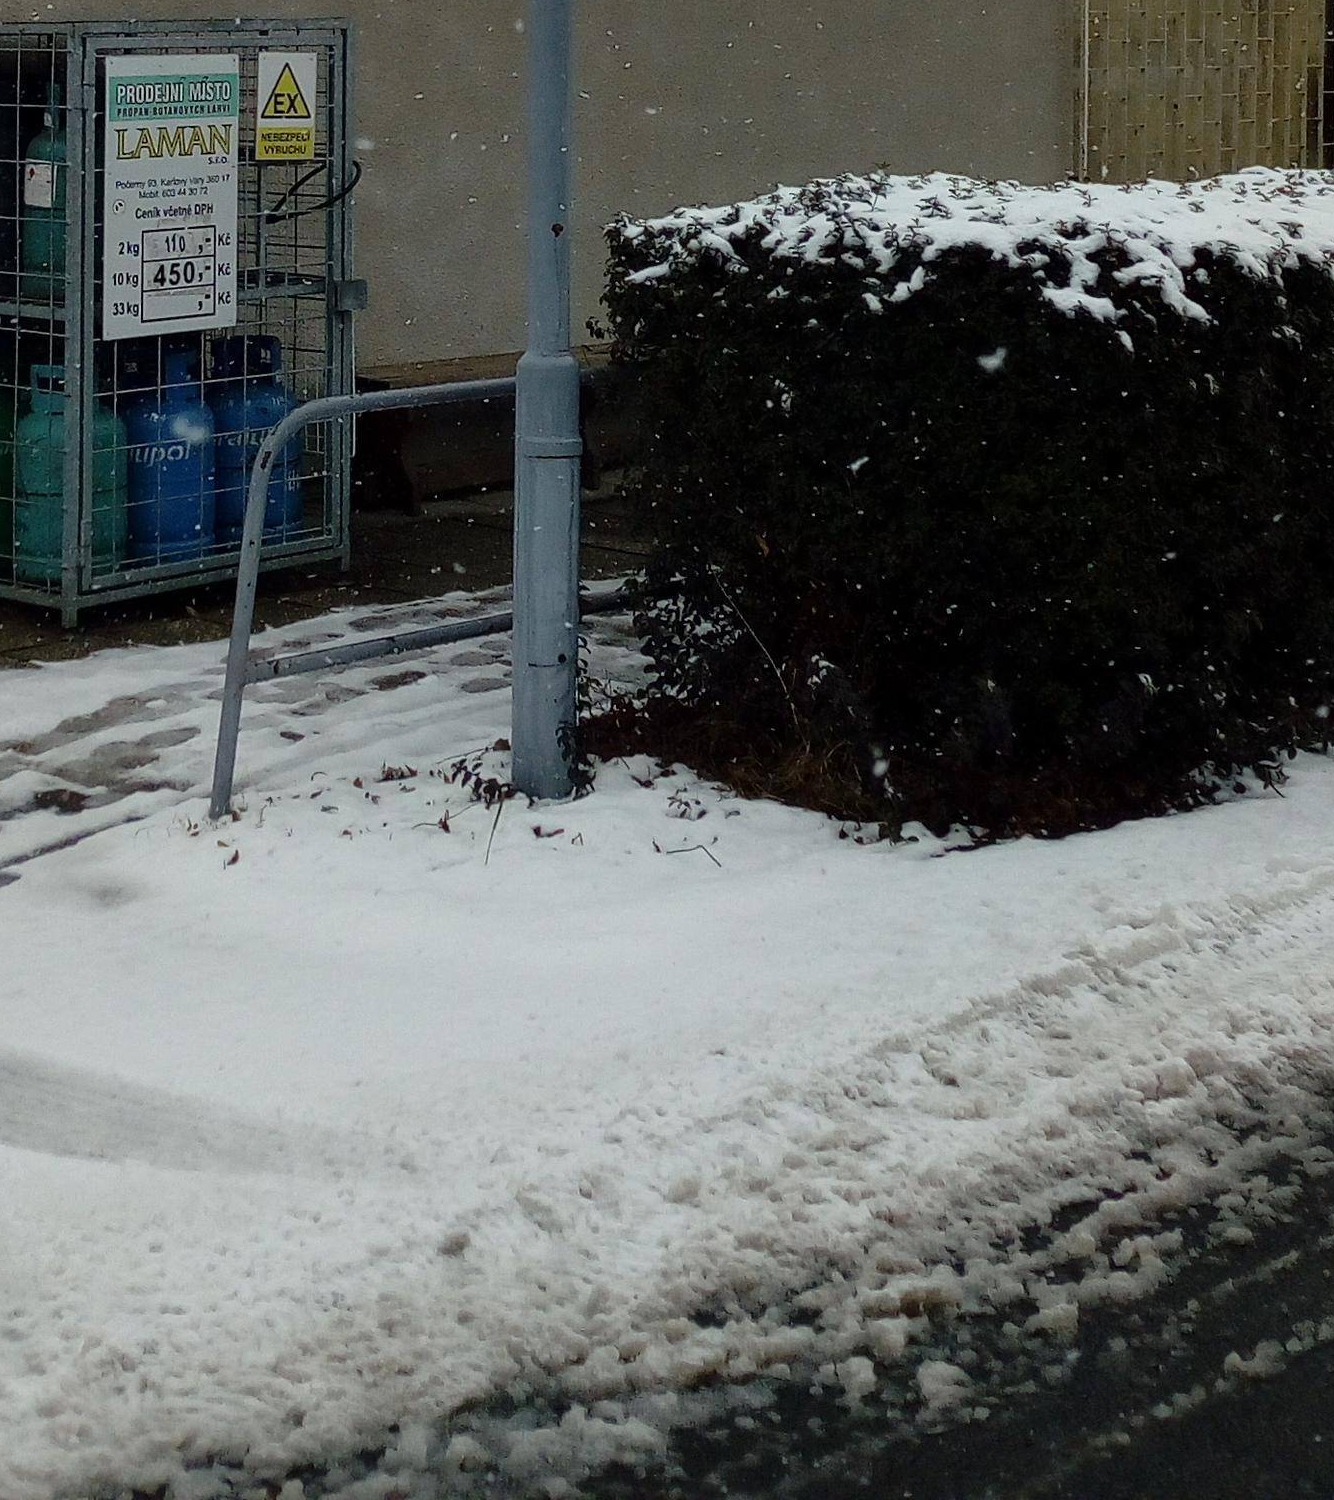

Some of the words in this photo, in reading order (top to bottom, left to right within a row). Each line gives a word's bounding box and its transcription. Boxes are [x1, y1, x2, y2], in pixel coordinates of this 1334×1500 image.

[117, 77, 185, 105] PRODEJNÍ
[188, 76, 231, 102] MÍSTO
[273, 92, 299, 114] EX
[114, 124, 232, 160] LAMAN
[135, 206, 161, 220] Ceník
[194, 204, 214, 215] DPH
[118, 242, 125, 255] 2
[127, 241, 139, 257] kg
[217, 232, 231, 246] Kč
[113, 272, 124, 286] 10
[125, 272, 139, 288] kg
[217, 262, 231, 276] Kč
[113, 302, 125, 316] 33
[127, 302, 139, 317] kg
[217, 291, 231, 304] Kč
